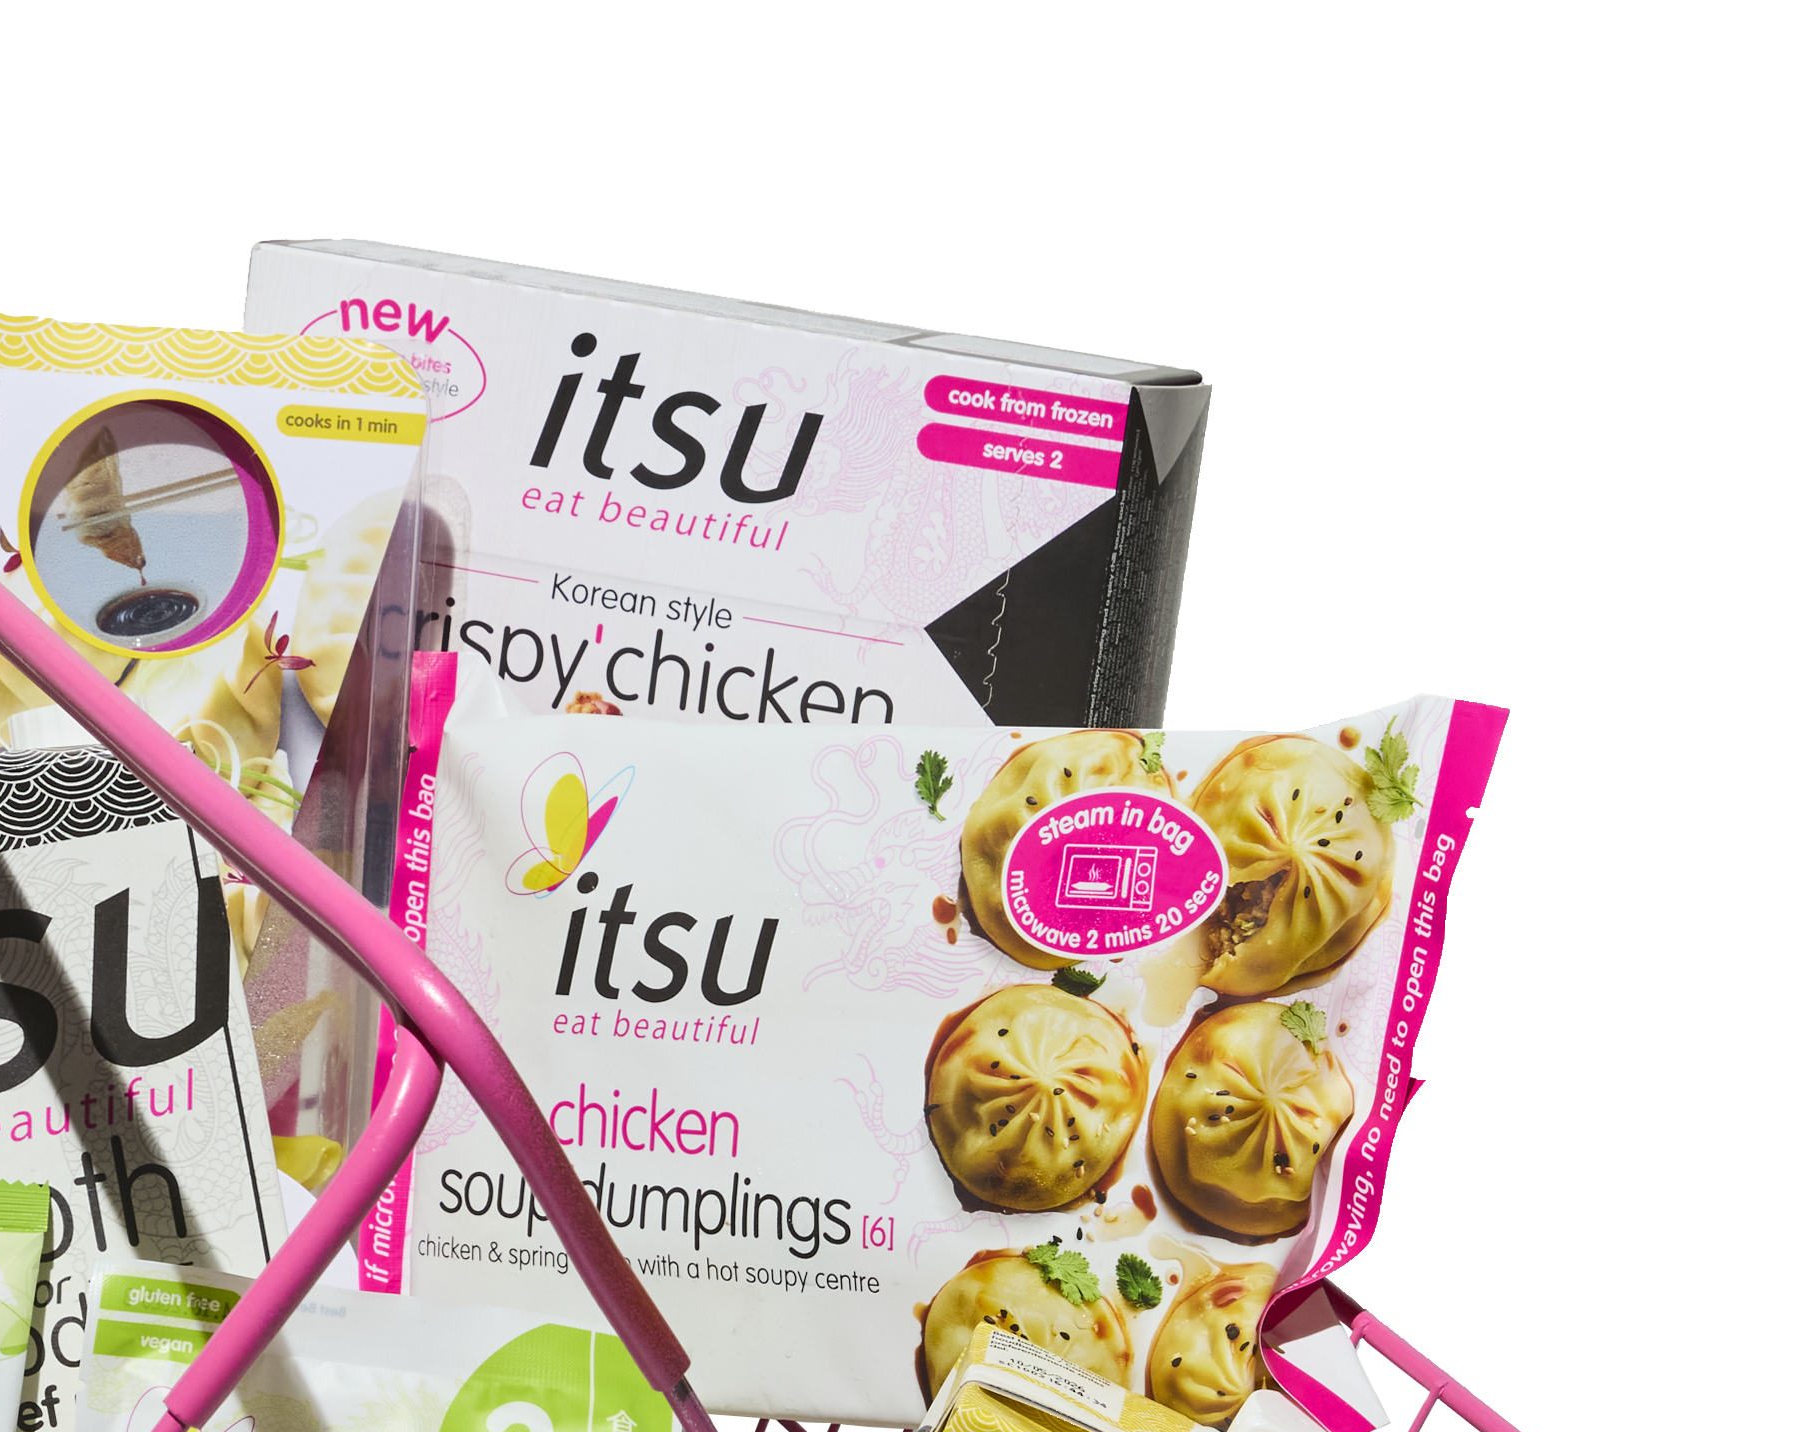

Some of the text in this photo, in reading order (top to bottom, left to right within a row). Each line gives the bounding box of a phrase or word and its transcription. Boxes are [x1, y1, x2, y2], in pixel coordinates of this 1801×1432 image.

[341, 298, 450, 344] new
[410, 352, 452, 375] bites
[423, 378, 459, 398] style
[285, 410, 398, 434] cooks in 1 min
[529, 332, 824, 505] itsu
[948, 388, 1114, 429] cook from frozen
[982, 441, 1064, 470] serves 2
[521, 487, 789, 552] eat beautiful
[551, 573, 733, 630] Korean style
[1038, 800, 1195, 856] steam in bag
[1010, 870, 1220, 949] microwave 2 mins 20 secs
[556, 871, 779, 1006] itsu
[1360, 833, 1455, 1163] bag this open to need no
[366, 774, 437, 1284] if open this bag
[553, 1009, 761, 1045] eat beautiful
[549, 1083, 740, 1157] chicken
[863, 1215, 895, 1251] [6]
[418, 1238, 880, 1294] chicken & spring with a hot soupy centre
[129, 1286, 221, 1312] gluten free
[140, 1333, 194, 1355] vegan
